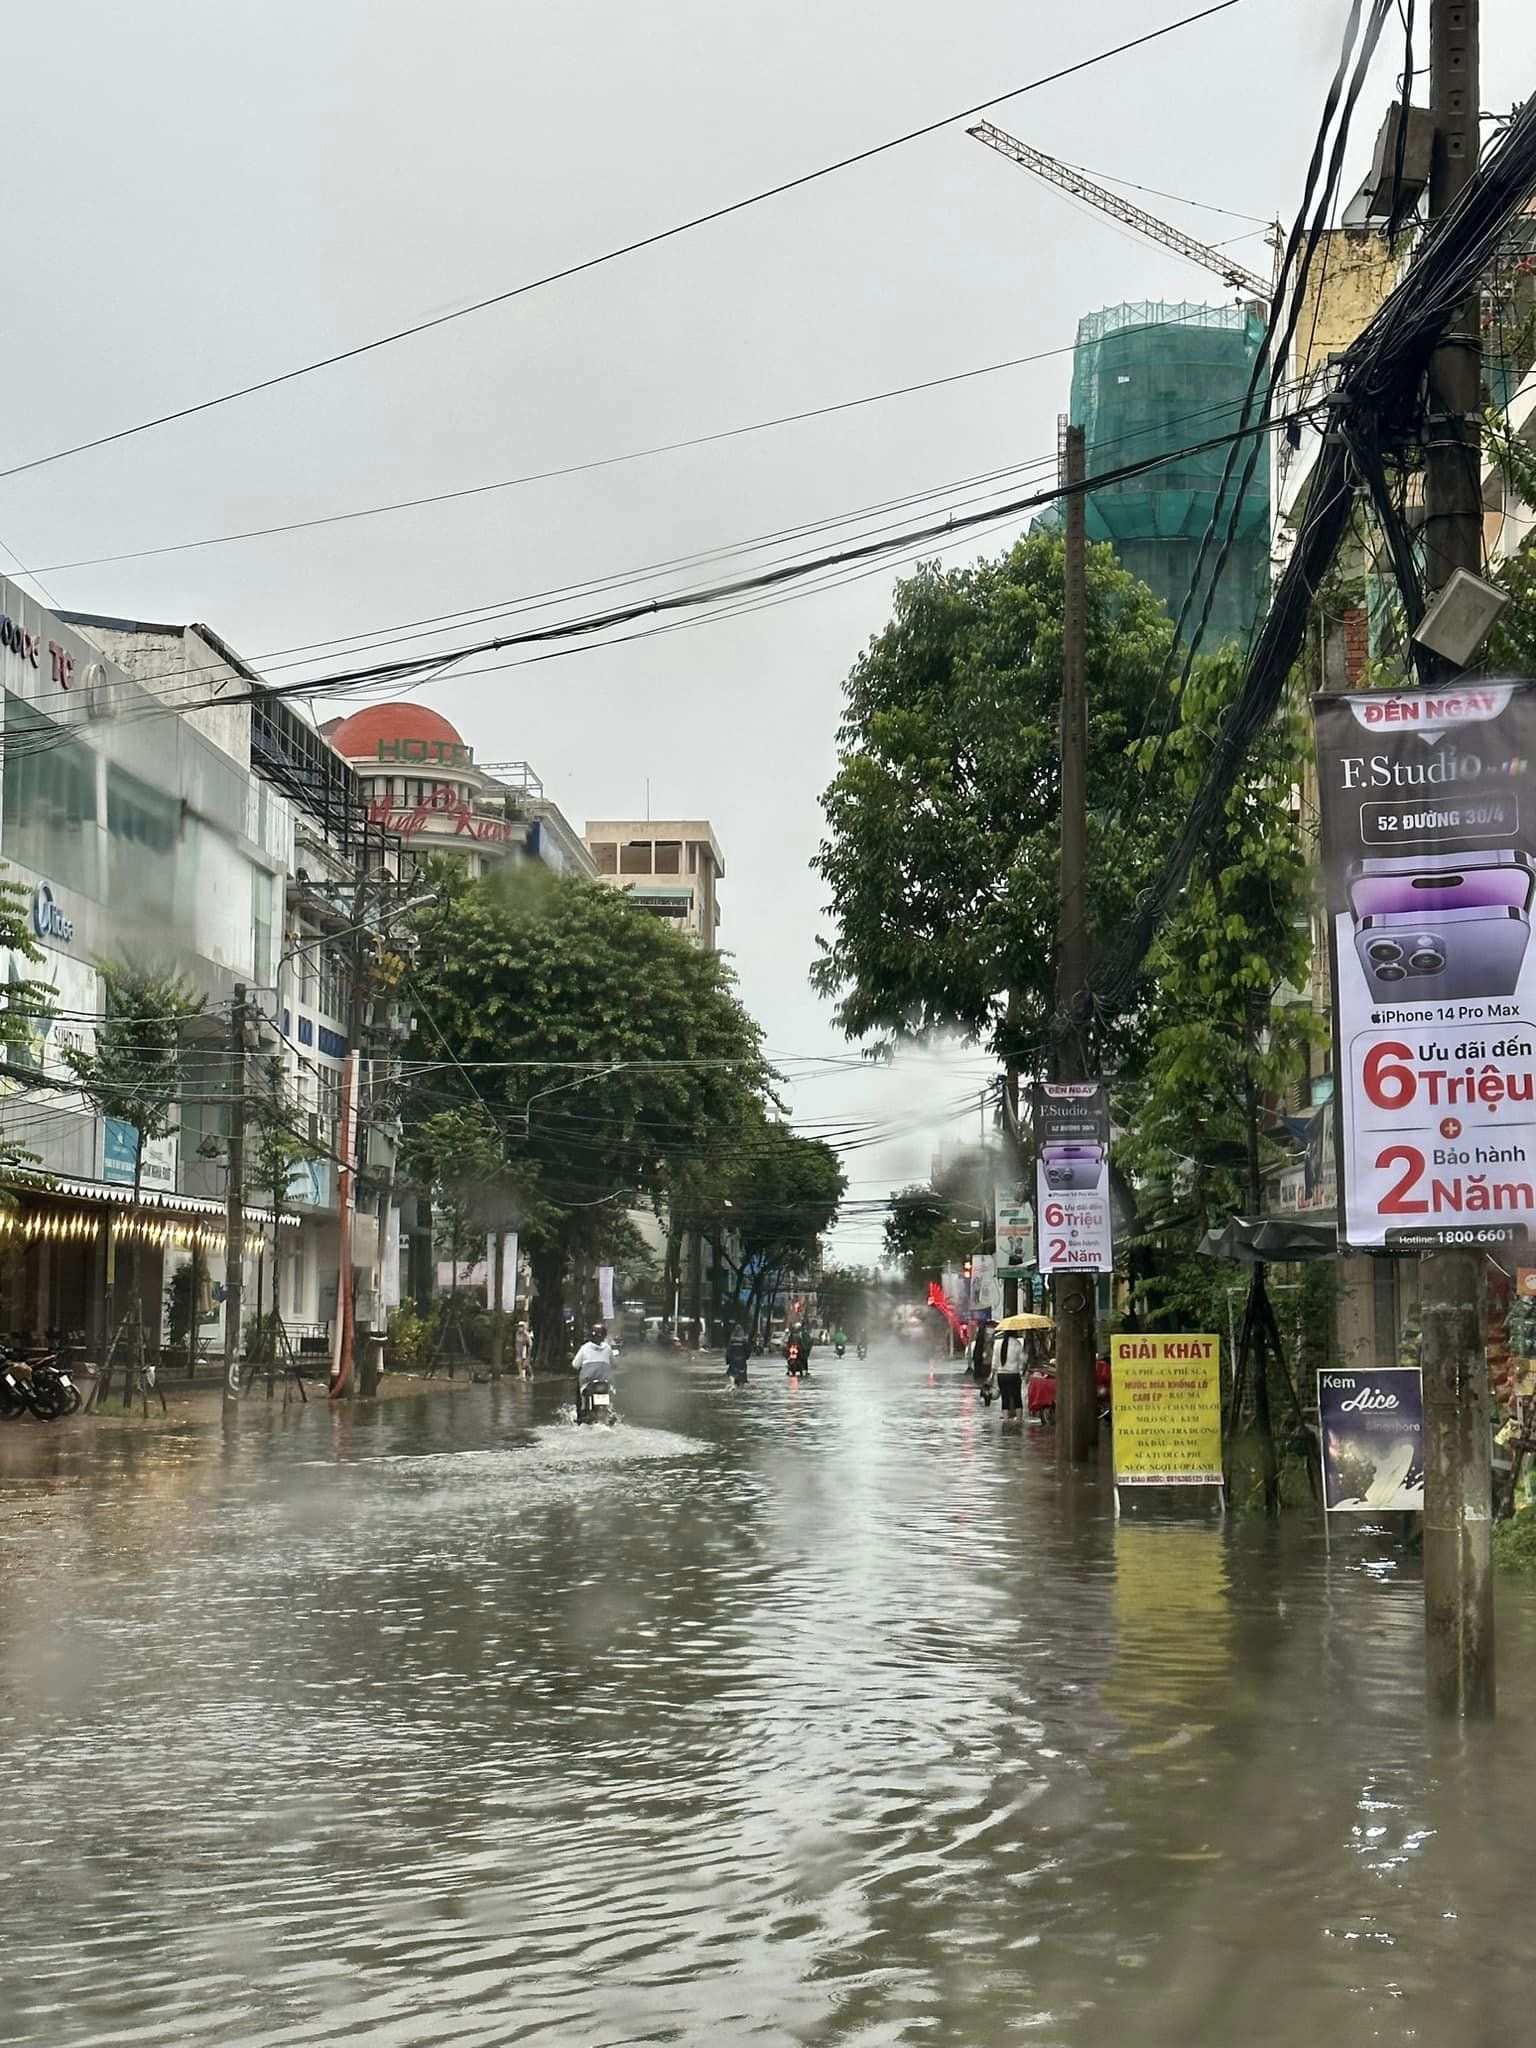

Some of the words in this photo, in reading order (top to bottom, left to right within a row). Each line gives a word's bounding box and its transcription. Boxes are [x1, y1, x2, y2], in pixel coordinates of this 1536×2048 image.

[1364, 695, 1419, 723] ĐẾN
[1425, 691, 1496, 719] NGAY
[378, 739, 474, 769] HOTEL
[1341, 747, 1481, 788] F.Studio
[1378, 816, 1398, 831] 52
[1403, 810, 1460, 830] ĐƯỜNG
[1465, 807, 1504, 824] 30/4
[1382, 1008, 1433, 1024] iPhone
[1437, 1008, 1454, 1021] 14
[1459, 1007, 1483, 1020] Pro
[1488, 1004, 1520, 1017] Max
[1419, 1045, 1449, 1061] Ưu
[1455, 1041, 1486, 1059] đãi
[1492, 1035, 1532, 1057] đến
[1363, 1041, 1417, 1110] 6
[1418, 1064, 1534, 1112] Triệu
[1433, 1147, 1470, 1165] Bảo
[1475, 1145, 1525, 1163] hành
[1375, 1145, 1429, 1215] 2
[1432, 1174, 1534, 1212] Năm
[1046, 1203, 1064, 1227] 6
[1064, 1212, 1103, 1228] Triệu
[1400, 1235, 1435, 1245] Hotline:
[1437, 1231, 1474, 1243] 1800
[1478, 1229, 1514, 1242] 6601
[1049, 1239, 1067, 1263] 2
[1068, 1250, 1102, 1262] Năm
[1119, 1338, 1157, 1359] GIẢI
[1164, 1340, 1213, 1359] KHÁT
[1323, 1375, 1355, 1389] Kem
[1341, 1387, 1400, 1412] Aice
